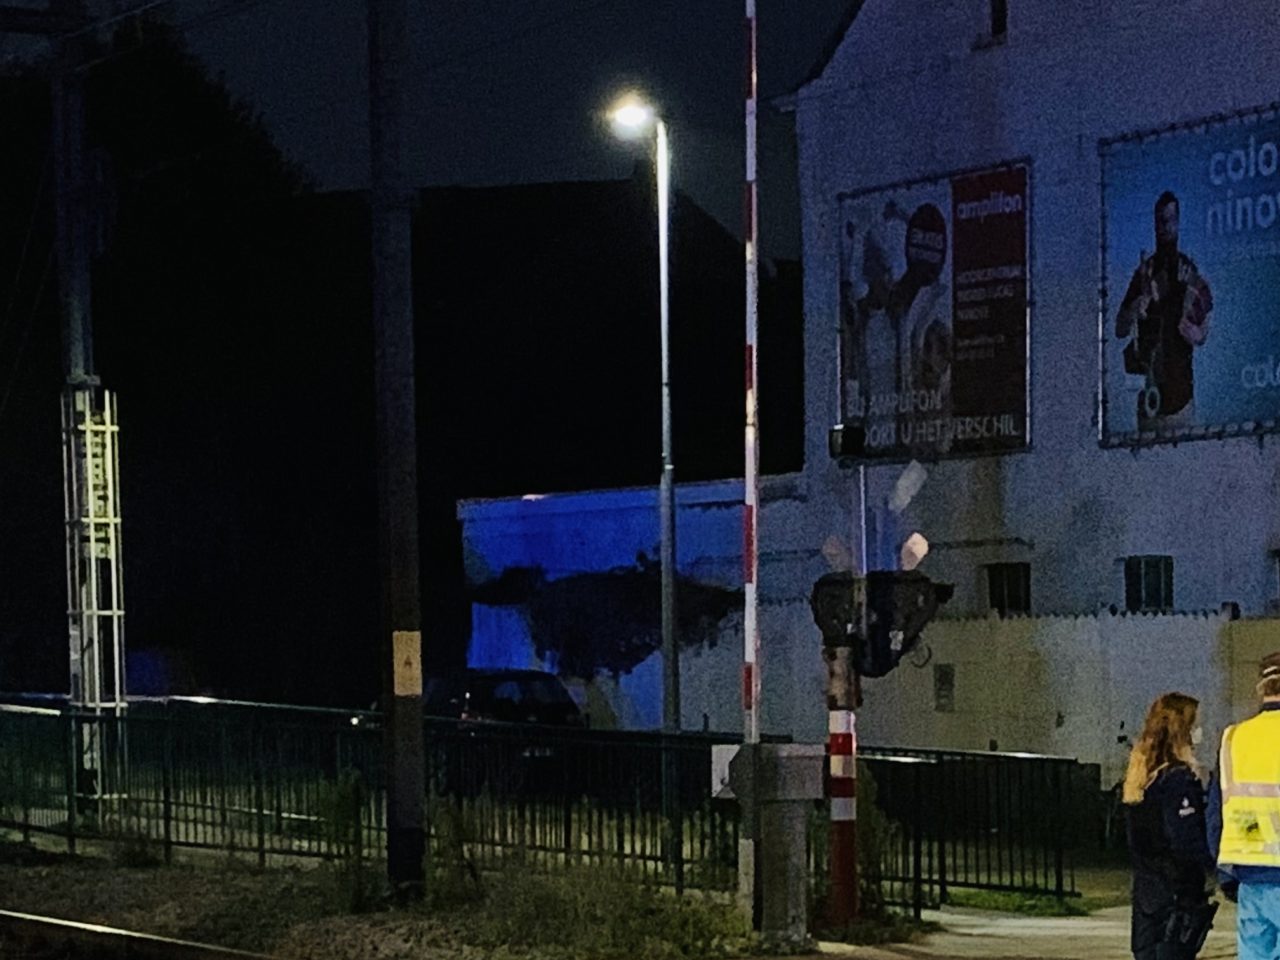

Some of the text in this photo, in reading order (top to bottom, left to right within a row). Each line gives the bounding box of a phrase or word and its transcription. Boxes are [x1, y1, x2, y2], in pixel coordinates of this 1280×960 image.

[957, 190, 1023, 224] amplifon
[868, 389, 943, 417] AMPLIFON
[900, 420, 914, 445] U
[915, 420, 943, 443] HET
[946, 413, 1021, 441] VERSCHIL
